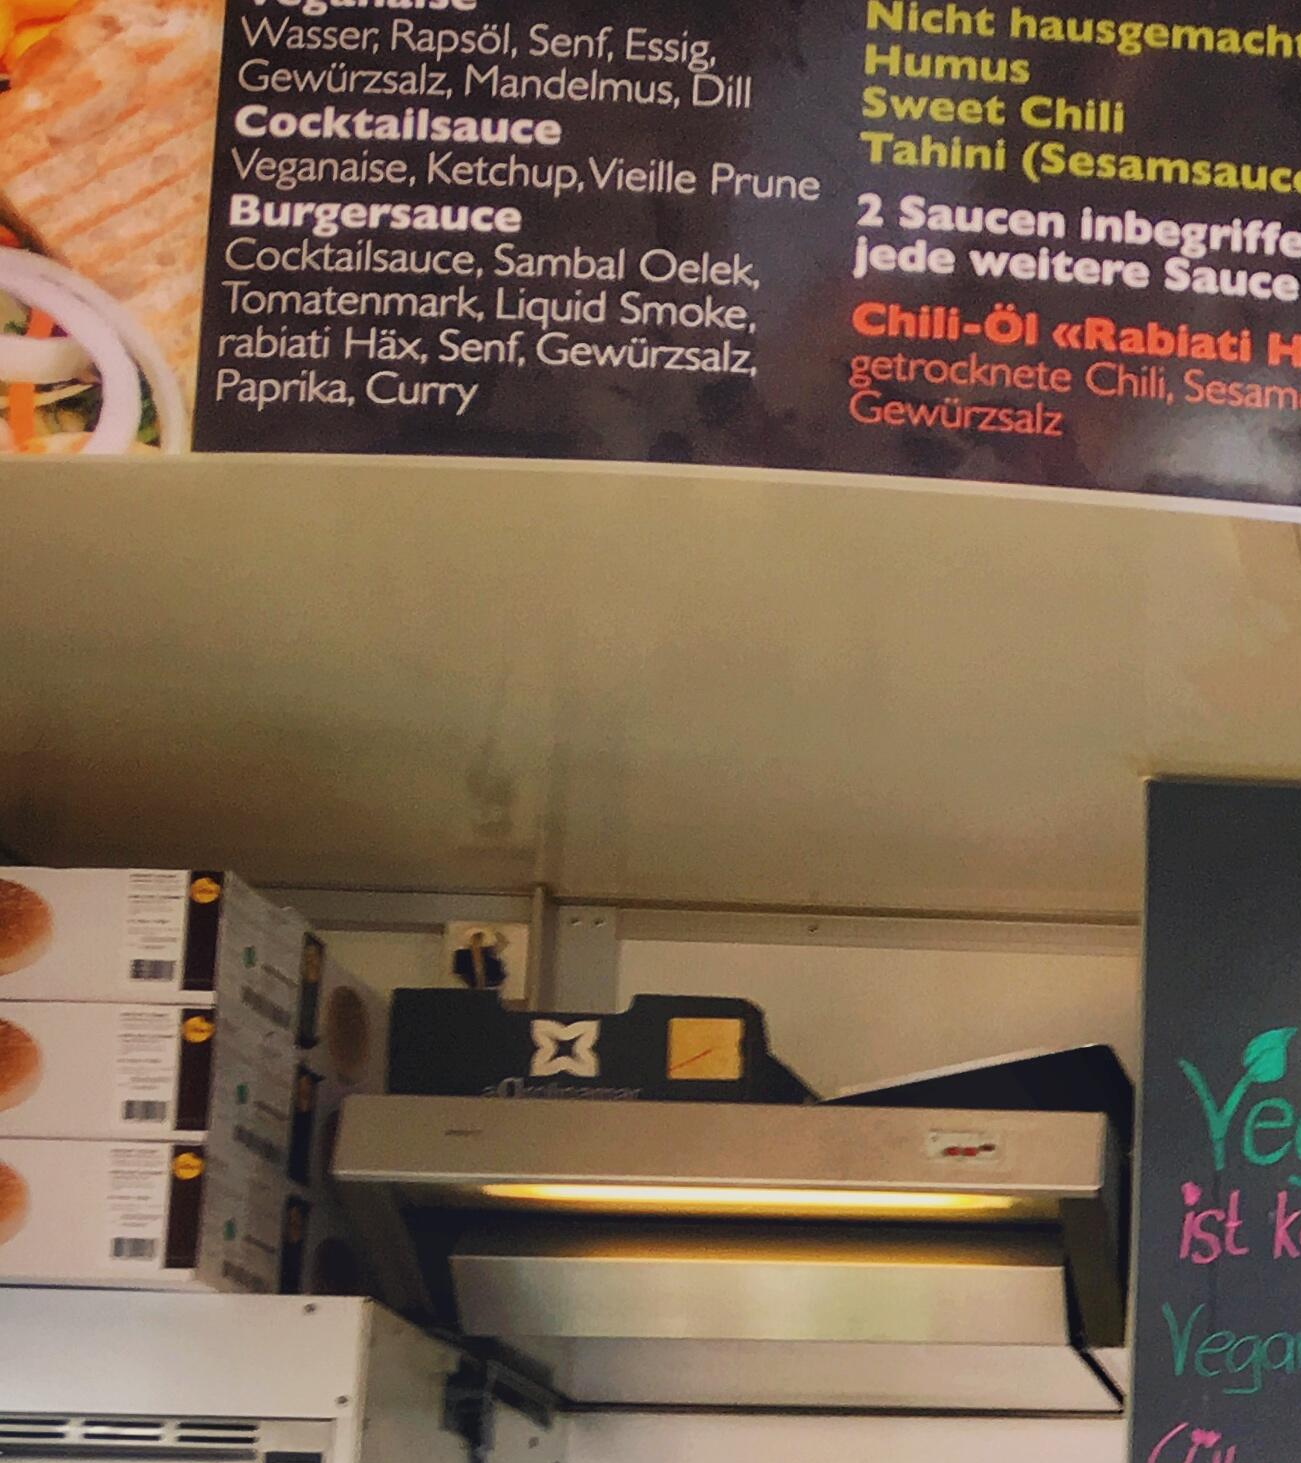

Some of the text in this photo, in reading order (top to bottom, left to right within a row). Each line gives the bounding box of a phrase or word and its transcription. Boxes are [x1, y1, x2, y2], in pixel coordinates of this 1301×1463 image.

[241, 15, 716, 73] Wasser, Rapsöl, Senf, Essig,
[866, 0, 995, 37] Nicht
[237, 58, 752, 109] Gewürzsalz, Mandelmus, Dill
[863, 44, 1030, 85] Humus
[234, 104, 562, 146] Cocktailsauce
[861, 86, 1126, 134] Sweet Chili
[231, 146, 821, 201] Veganaise, Ketchup, Vieille Prune
[859, 131, 1007, 172] Tahini
[228, 193, 522, 237] Burgersauce
[856, 192, 885, 229] 2
[898, 194, 1067, 240] Saucen
[225, 236, 760, 290] Cocktailsauce, Sambal Oelek,
[853, 236, 957, 279] jede
[969, 246, 1151, 289] weitere
[1164, 257, 1300, 302] Sauce
[221, 279, 757, 334] Tomatenmark, Liquid Smoke,
[218, 325, 758, 377] rabiati Häx, Senf, Gewürzsalz,
[851, 302, 1040, 348] Chili-Öl
[1052, 315, 1252, 365] «Rabiati
[216, 368, 479, 416] Paprika, Curry
[849, 352, 1072, 393] getrocknete
[1085, 361, 1173, 405] Chili,
[849, 389, 1063, 437] Gewürzsalz
[1179, 1181, 1249, 1265] ist
